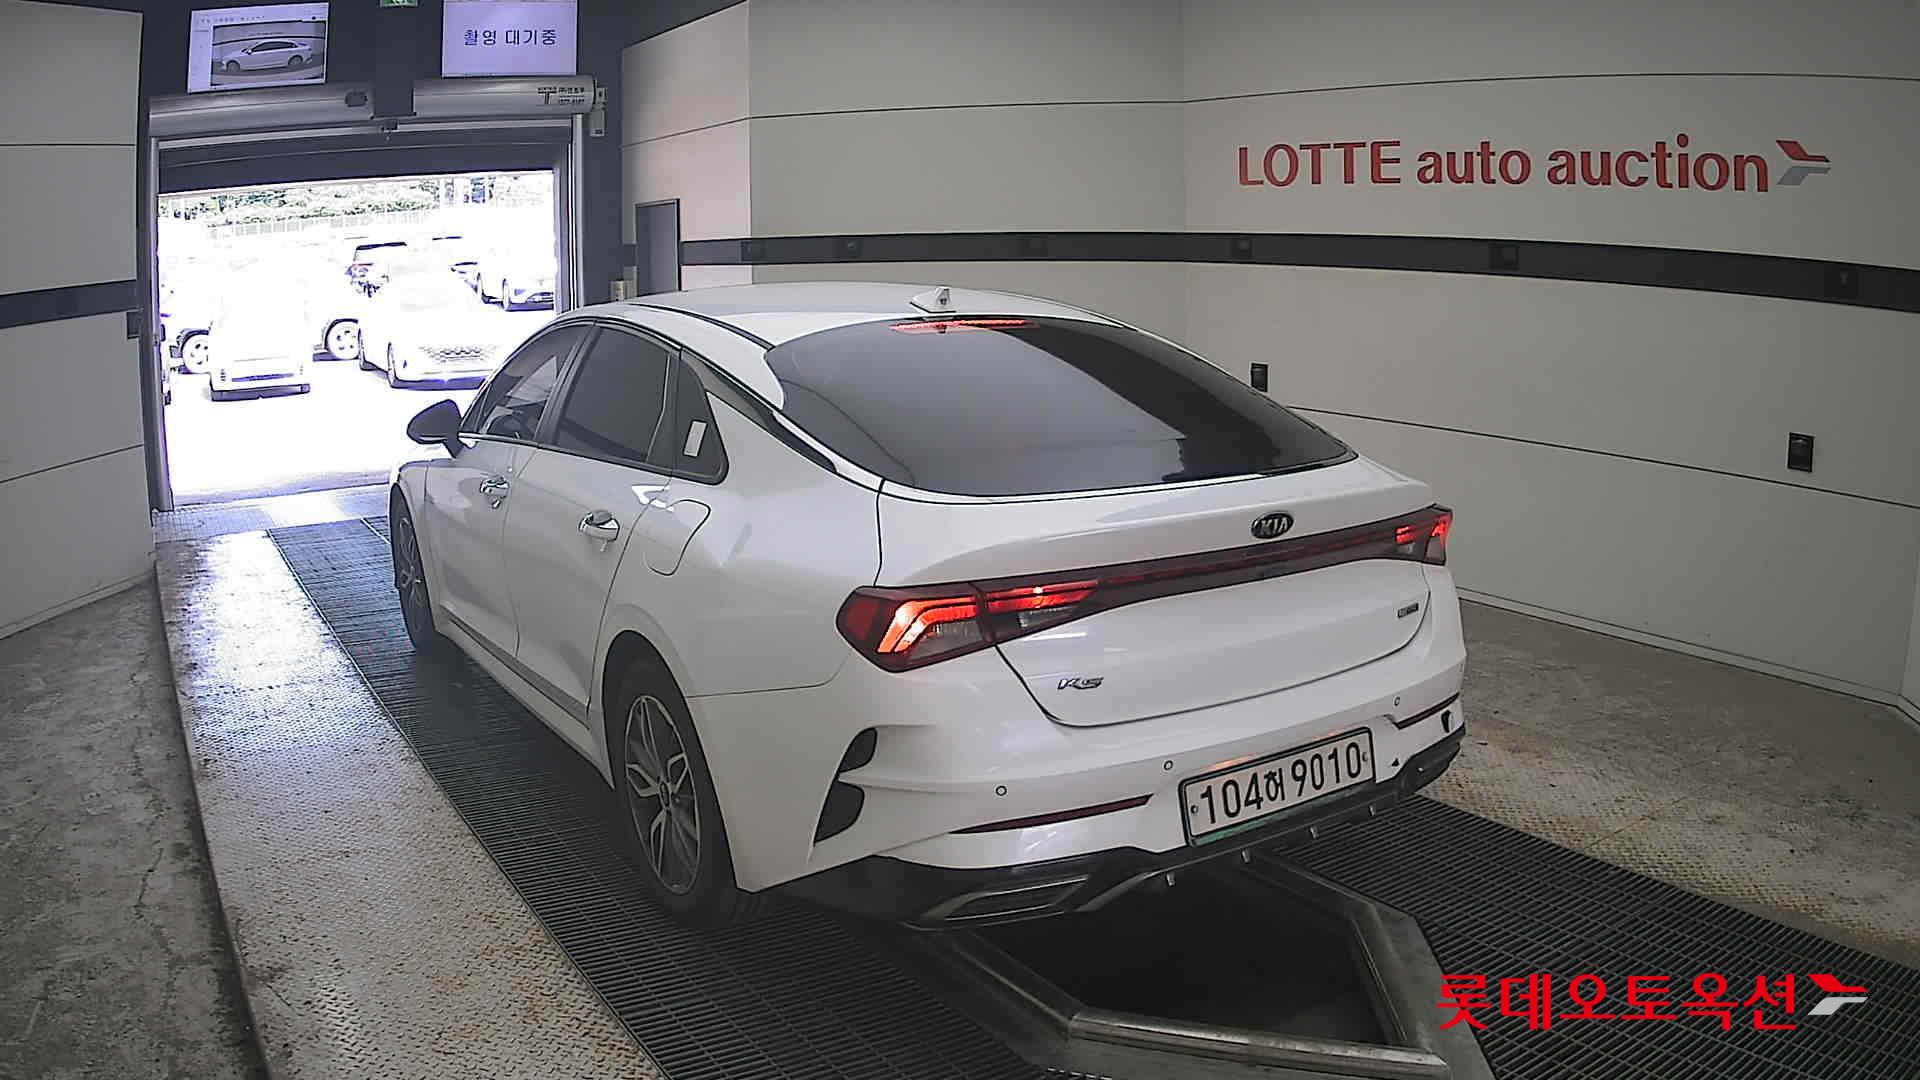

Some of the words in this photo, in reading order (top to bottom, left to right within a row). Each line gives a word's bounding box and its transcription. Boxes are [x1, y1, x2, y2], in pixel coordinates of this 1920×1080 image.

[505, 29, 557, 46] 대기중
[1238, 140, 1401, 186] LOTTE
[1416, 141, 1532, 185] auto
[1547, 133, 1769, 193] auction
[1257, 516, 1290, 537] KIA
